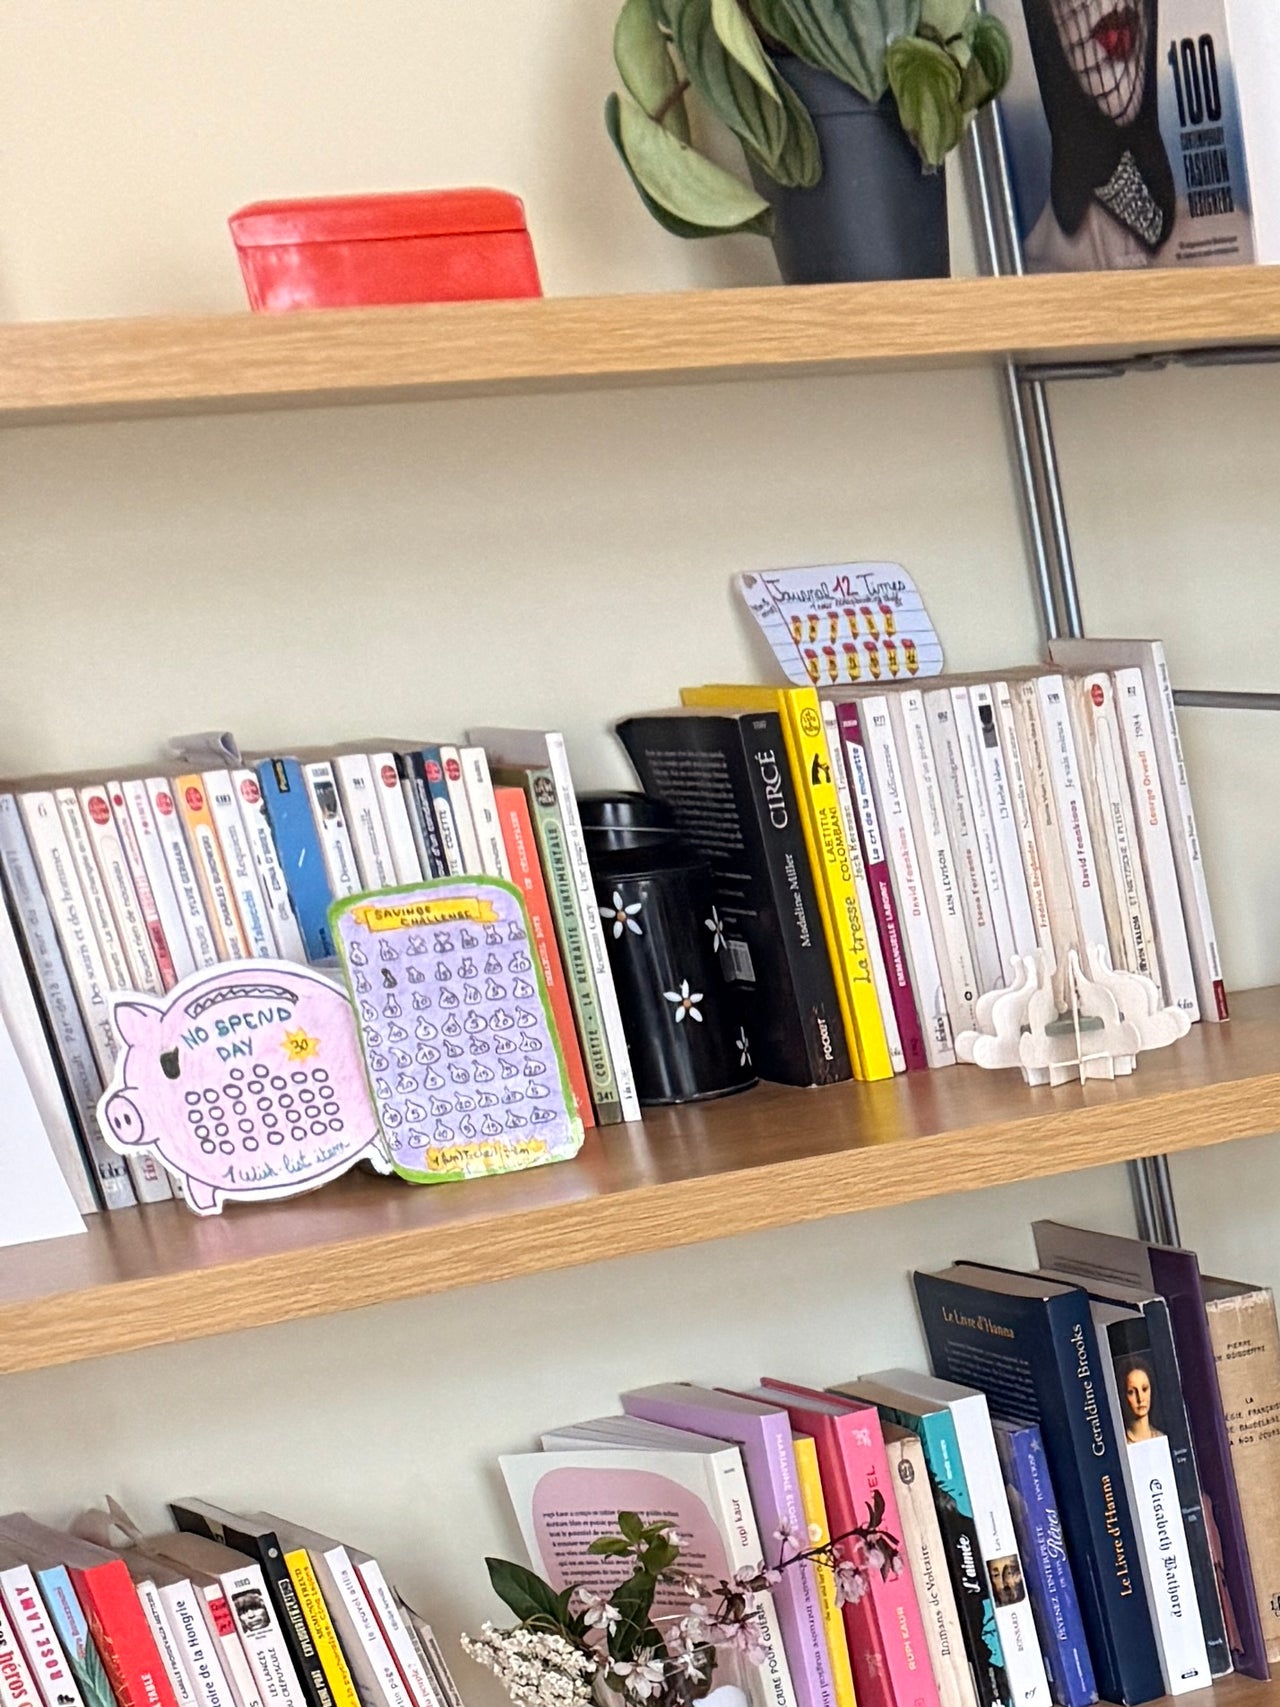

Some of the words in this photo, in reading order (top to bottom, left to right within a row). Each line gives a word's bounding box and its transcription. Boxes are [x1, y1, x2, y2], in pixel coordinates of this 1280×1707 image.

[1168, 34, 1222, 127] 100
[1184, 148, 1230, 187] FASHION
[765, 578, 835, 603] Journal
[833, 576, 858, 598] 12
[857, 573, 906, 595] Times
[754, 746, 792, 831] CIRCÉ
[849, 745, 869, 795] mouette
[862, 809, 875, 825] de
[1142, 786, 1161, 826] George
[817, 806, 838, 863] LAETITIA
[826, 804, 853, 882] COLOMBANI
[46, 845, 73, 902] hommes
[109, 859, 130, 906] nouveau
[546, 826, 575, 917] SENTIMENTALE
[781, 851, 800, 890] Miller
[934, 848, 953, 892] LEVISON
[963, 847, 981, 894] Ferrante
[1077, 856, 1091, 888] David
[62, 903, 80, 927] des
[213, 884, 234, 927] CHARLES
[240, 887, 267, 943] Tabucchi
[789, 890, 812, 947] Madeline
[906, 884, 923, 917] David
[943, 893, 957, 916] IAIN
[972, 896, 986, 927] Elena
[126, 923, 142, 946] rien
[838, 894, 867, 954] tresse
[74, 943, 95, 979] souris
[567, 925, 588, 983] RETRAITE
[851, 956, 873, 986] La
[886, 921, 909, 987] EMMANUELLE
[85, 981, 104, 1007] Des
[580, 991, 593, 1007] LA
[181, 1026, 209, 1050] NO
[215, 1007, 292, 1037] SPEND
[291, 1039, 308, 1050] 30
[816, 1016, 835, 1061] POCKET
[932, 1016, 948, 1043] folio
[216, 1036, 253, 1062] DAY
[589, 1029, 608, 1079] COLETTE
[1065, 1323, 1093, 1378] Brooks
[1076, 1379, 1110, 1457] Geraldine
[1244, 1397, 1254, 1405] LA
[774, 1432, 793, 1490] MARIANNE
[1026, 1451, 1040, 1479] CRISP
[729, 1497, 744, 1522] kaur
[1032, 1478, 1045, 1501] TONY
[1094, 1472, 1124, 1538] d'Hanna
[1143, 1476, 1175, 1551] Elisabeth
[735, 1523, 751, 1548] rupi
[1038, 1506, 1069, 1563] Rêves
[916, 1542, 937, 1589] Voltaire
[953, 1533, 982, 1595] L'aimée
[1108, 1537, 1131, 1575] Livre
[292, 1565, 312, 1600] FREUD
[927, 1590, 941, 1607] de
[1116, 1573, 1135, 1596] Le
[1158, 1551, 1188, 1619] Bathory
[12, 1582, 45, 1634] LAMY
[171, 1597, 202, 1649] Hongrie
[751, 1601, 773, 1643] GUÉRIR
[895, 1605, 911, 1639] KAUR
[1049, 1594, 1069, 1641] DEVENEZ
[931, 1608, 952, 1657] Romans
[0, 1650, 27, 1699] héros
[34, 1635, 64, 1682] ROSE
[190, 1647, 206, 1663] la
[195, 1662, 212, 1680] de
[254, 1648, 273, 1682] LANCES
[764, 1643, 779, 1674] POUR
[902, 1639, 918, 1671] RUPI
[138, 1671, 160, 1703] TABLE
[264, 1680, 278, 1698] LES
[380, 1663, 400, 1689] page
